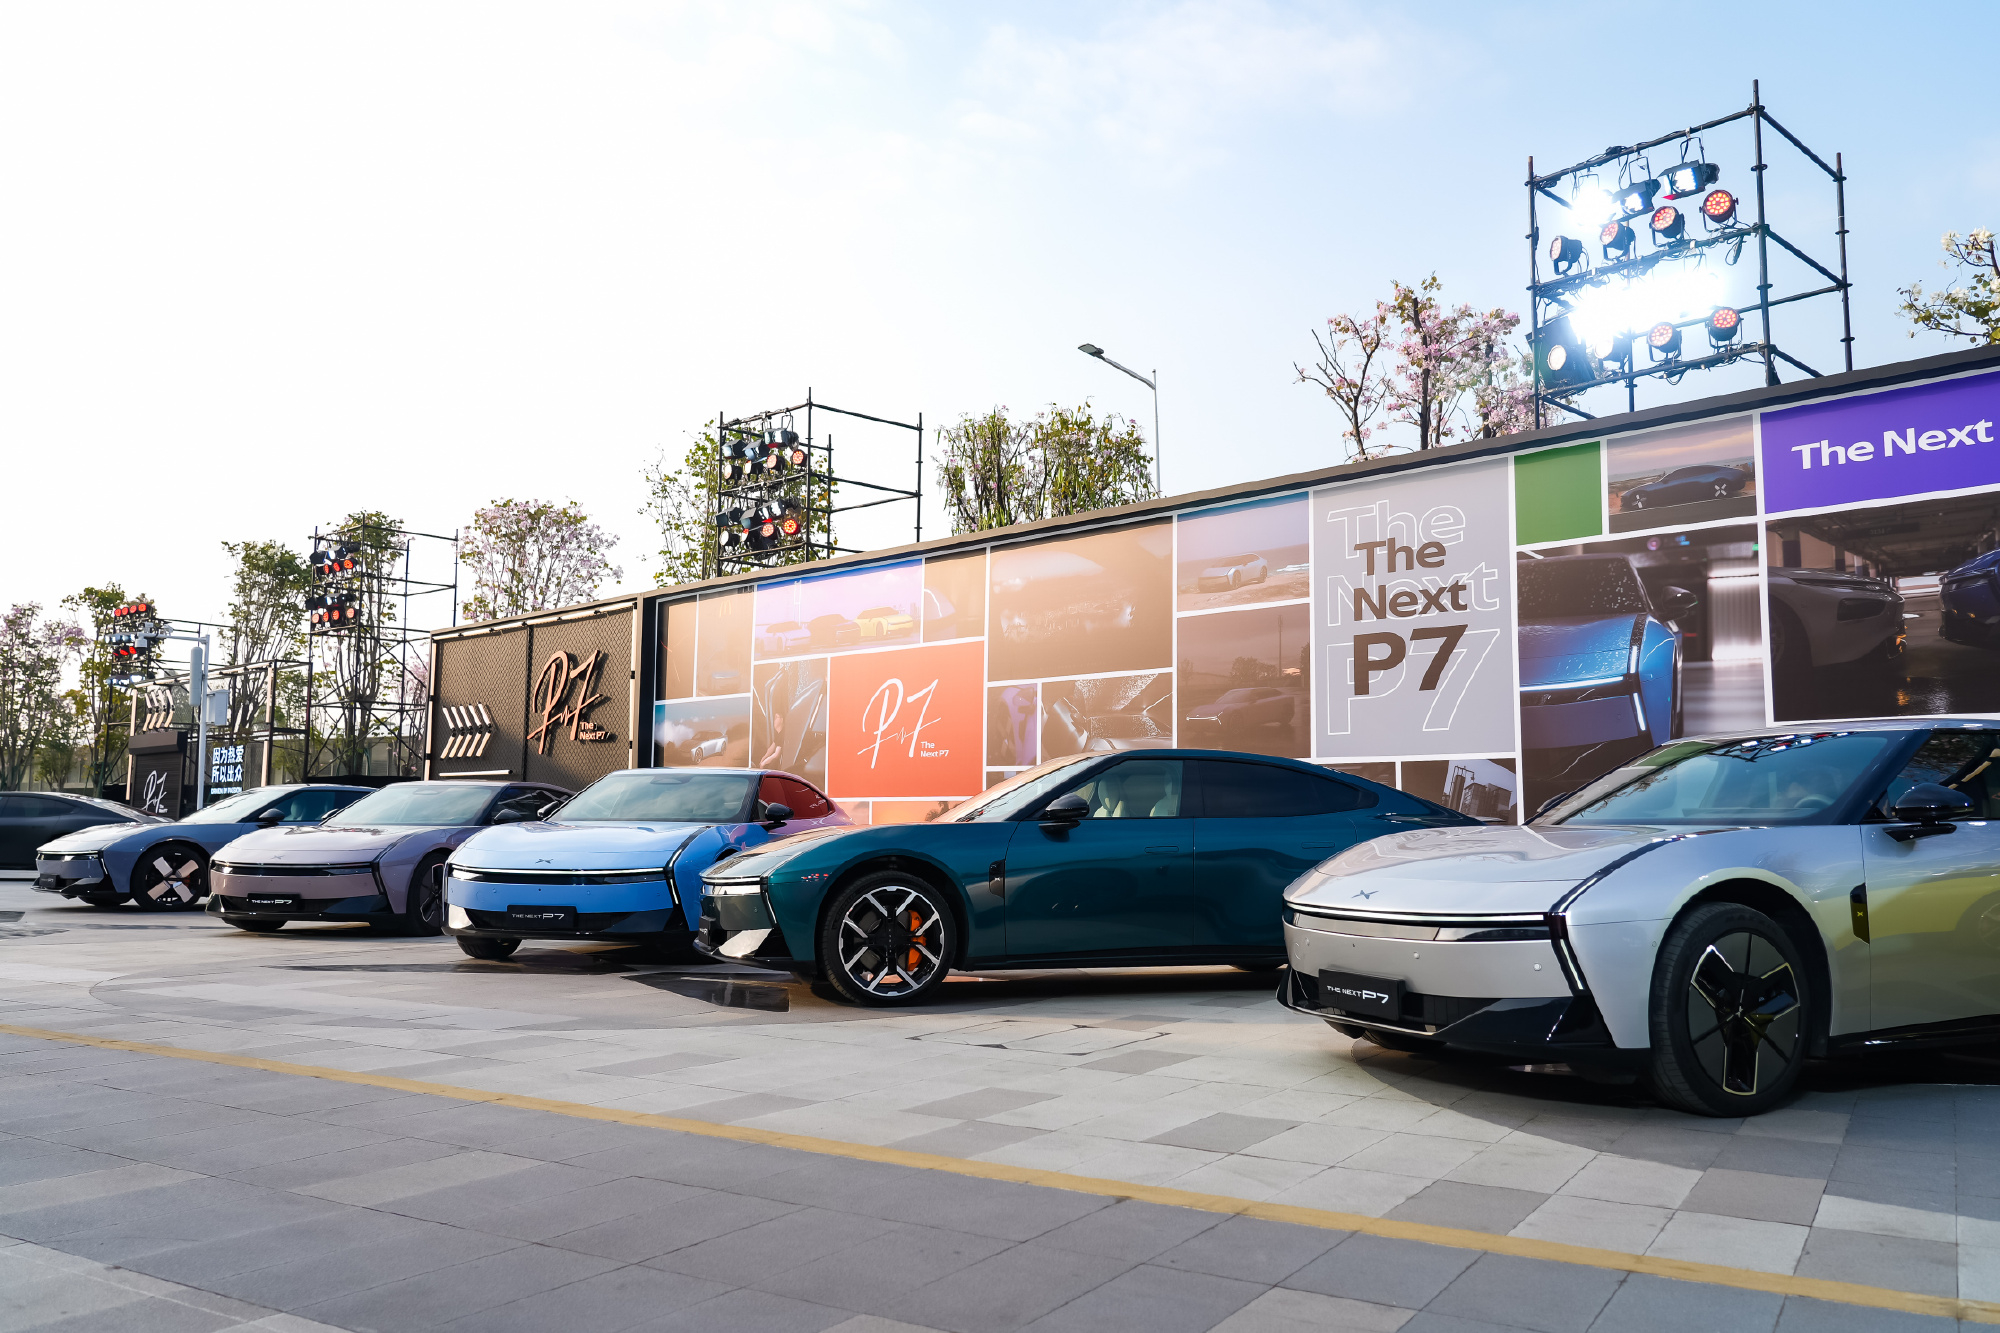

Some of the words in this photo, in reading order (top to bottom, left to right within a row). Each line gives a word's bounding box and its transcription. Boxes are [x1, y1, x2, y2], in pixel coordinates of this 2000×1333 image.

[1791, 440, 1875, 470] The
[1883, 418, 1994, 457] Next
[1327, 499, 1466, 559] The
[1354, 537, 1446, 576] The
[1327, 562, 1500, 627] Next
[1354, 580, 1468, 621] Next
[1354, 624, 1468, 695] P7
[1327, 628, 1500, 735] P7
[580, 721, 594, 730] The
[580, 731, 596, 740] Next
[596, 730, 606, 740] P7
[212, 745, 244, 765] 因为热爱
[920, 741, 935, 749] The
[920, 750, 938, 758] Next
[939, 749, 949, 757] P7
[211, 764, 243, 783] 所以出众
[1327, 985, 1341, 993] THE
[1342, 988, 1361, 997] NEXT
[1362, 989, 1389, 1003] P7
